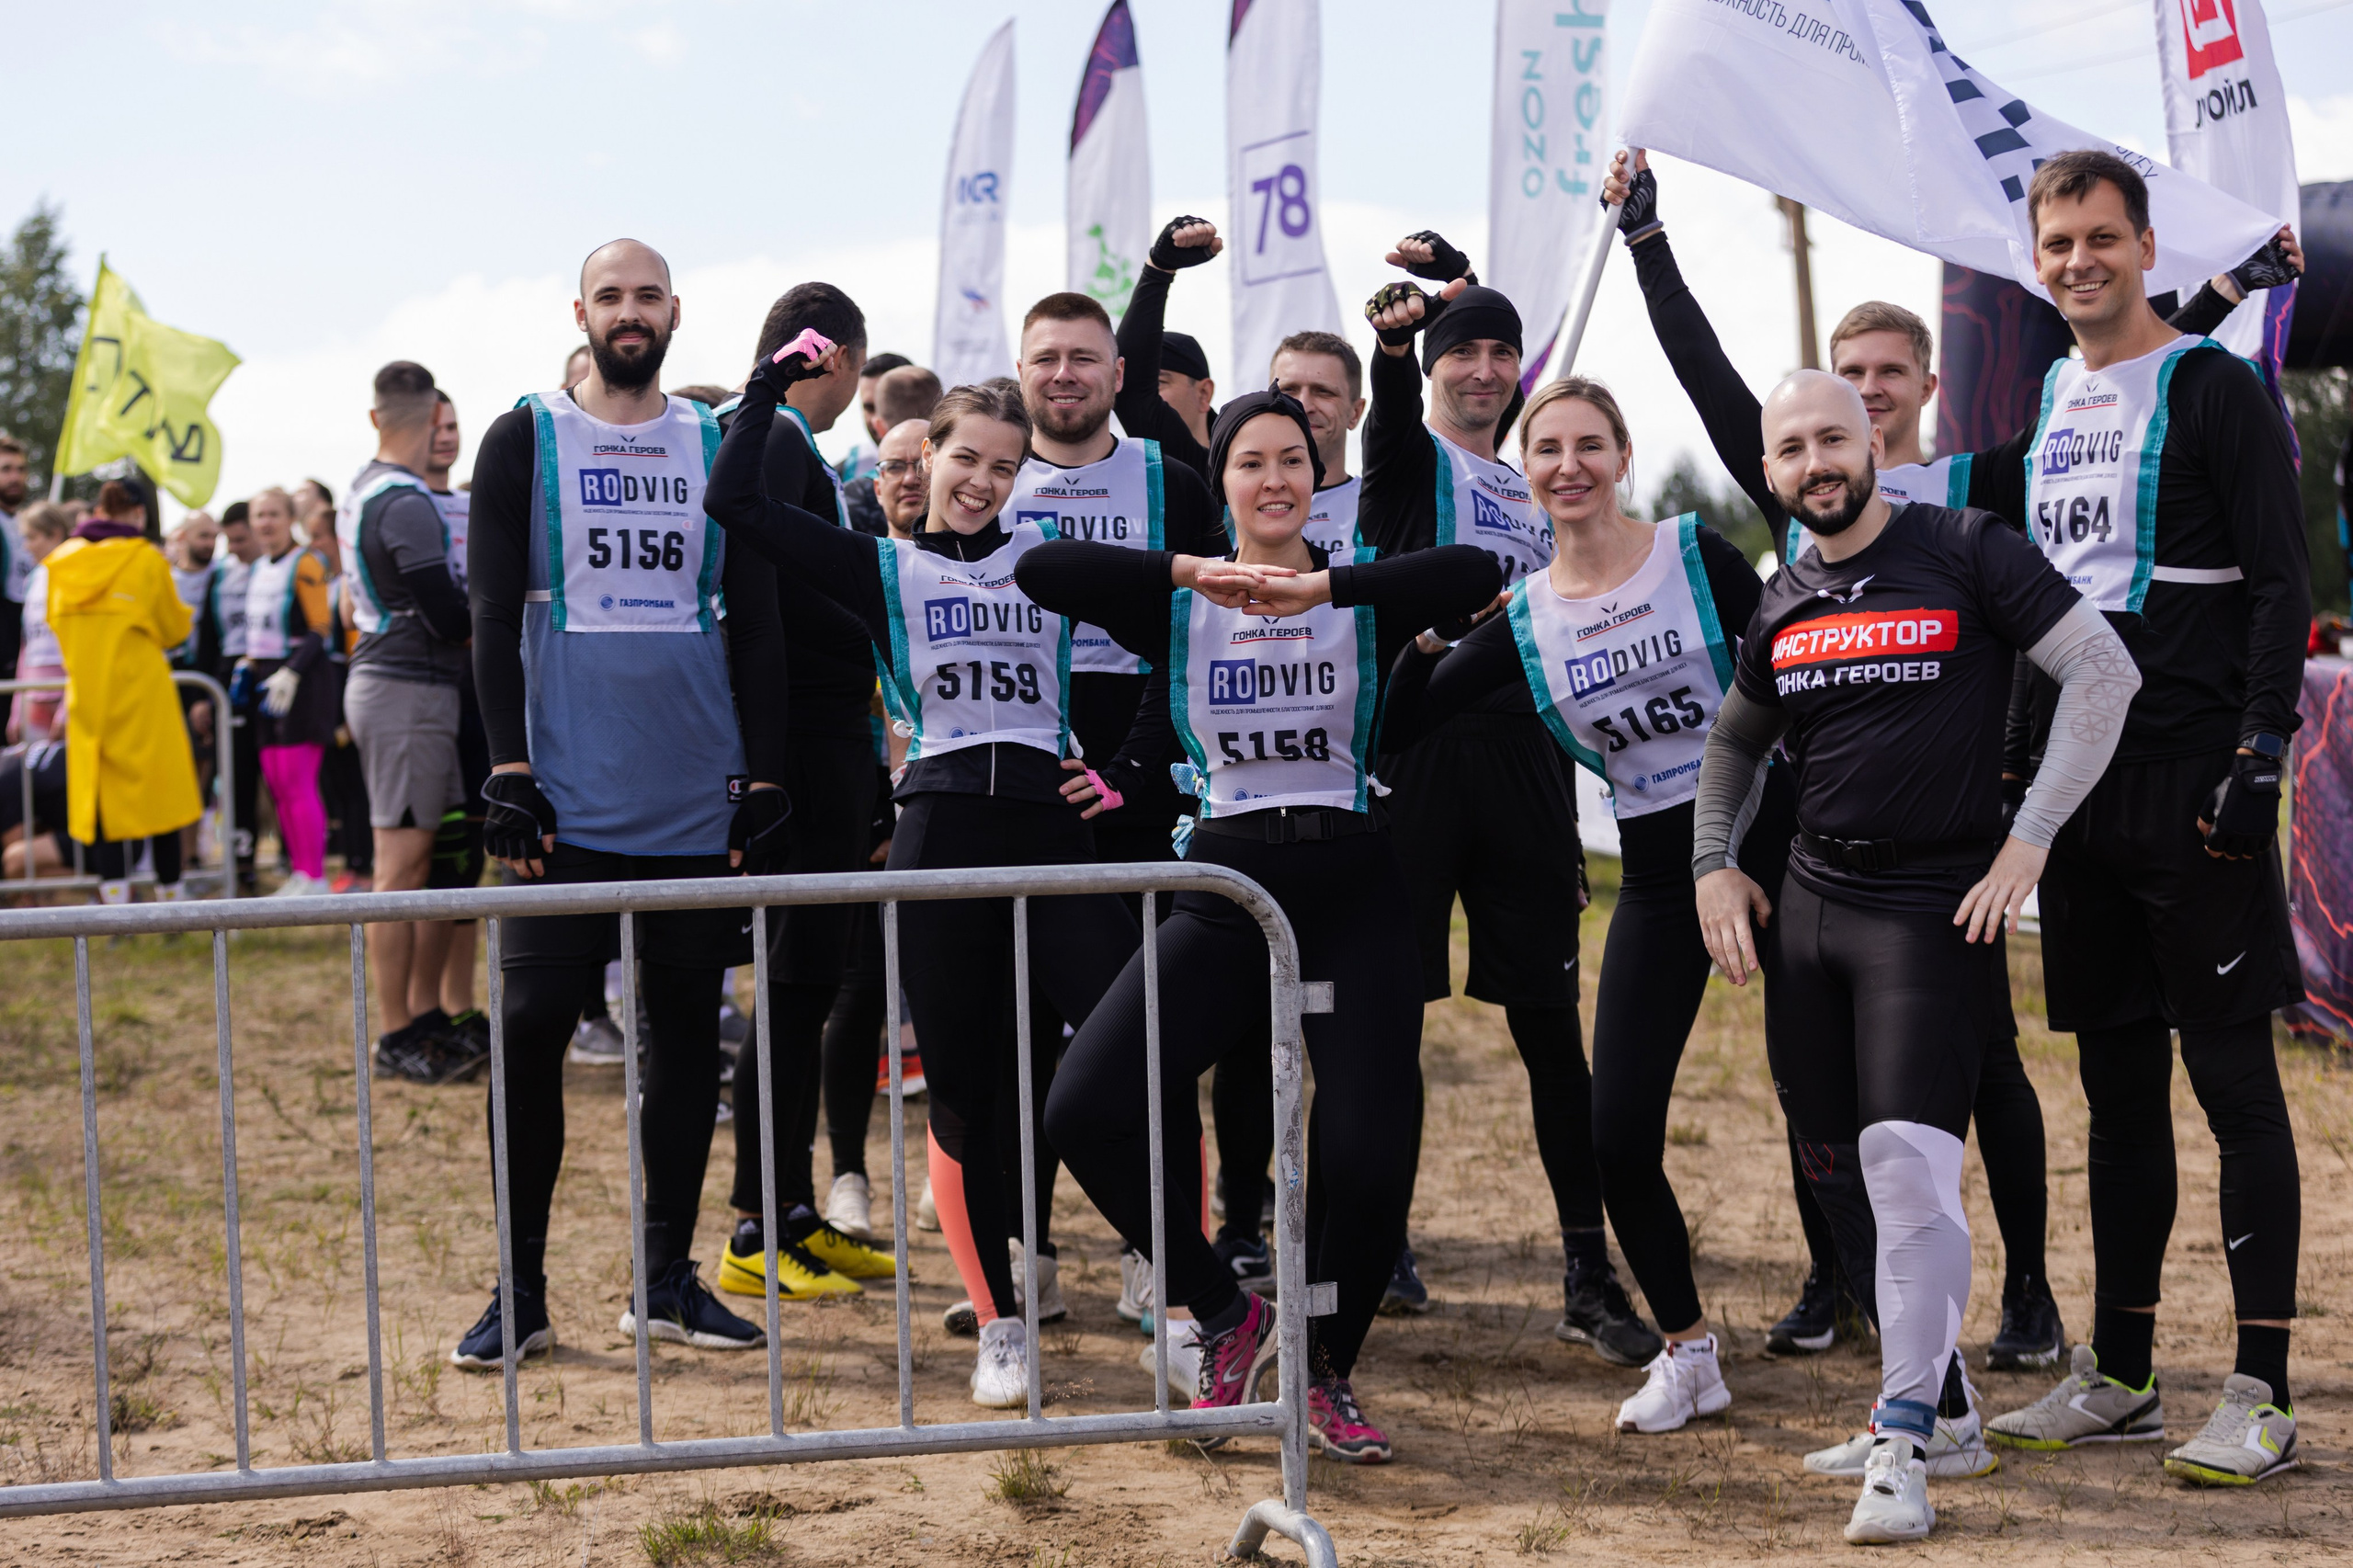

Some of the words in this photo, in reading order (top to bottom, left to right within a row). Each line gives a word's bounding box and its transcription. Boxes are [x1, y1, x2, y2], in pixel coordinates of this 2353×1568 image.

[1787, 13, 1830, 47] ДЛЯ
[1521, 50, 1546, 199] OZON
[1250, 163, 1312, 256] 78
[2067, 398, 2086, 409] ОНКА
[2087, 393, 2118, 405] ГЕРОЕВ
[594, 445, 627, 453] ГОНКА
[629, 446, 666, 455] ГЕРОЕВ
[2043, 430, 2123, 470] RODVIG
[581, 472, 688, 505] RODVIG
[1035, 487, 1067, 496] ГОНКА
[1070, 488, 1108, 496] ГЕРОЕВ
[2038, 496, 2112, 544] 5164
[588, 528, 685, 572] 5156
[620, 598, 676, 609] ГАЗПРОМБАНК
[927, 602, 1042, 635] RODVIG
[1577, 619, 1610, 639] ГОНКА
[1612, 603, 1652, 624] ГЕРОЕВ
[1233, 629, 1267, 642] ГОНКА
[1269, 626, 1313, 637] ГЕРОЕВ
[1771, 619, 1943, 664] ИНСТРУКТОР
[1571, 630, 1682, 693] RODVIG
[1834, 661, 1940, 687] ГЕРОЕВ
[936, 660, 1042, 705] 5159
[1212, 661, 1336, 699] RODVIG
[1281, 705, 1315, 713] БЛАГОСОСТОЯНИЕ
[1592, 686, 1705, 753] 5165
[1218, 726, 1331, 767] 5158
[1651, 756, 1704, 784] ГАЗПРОМБА
